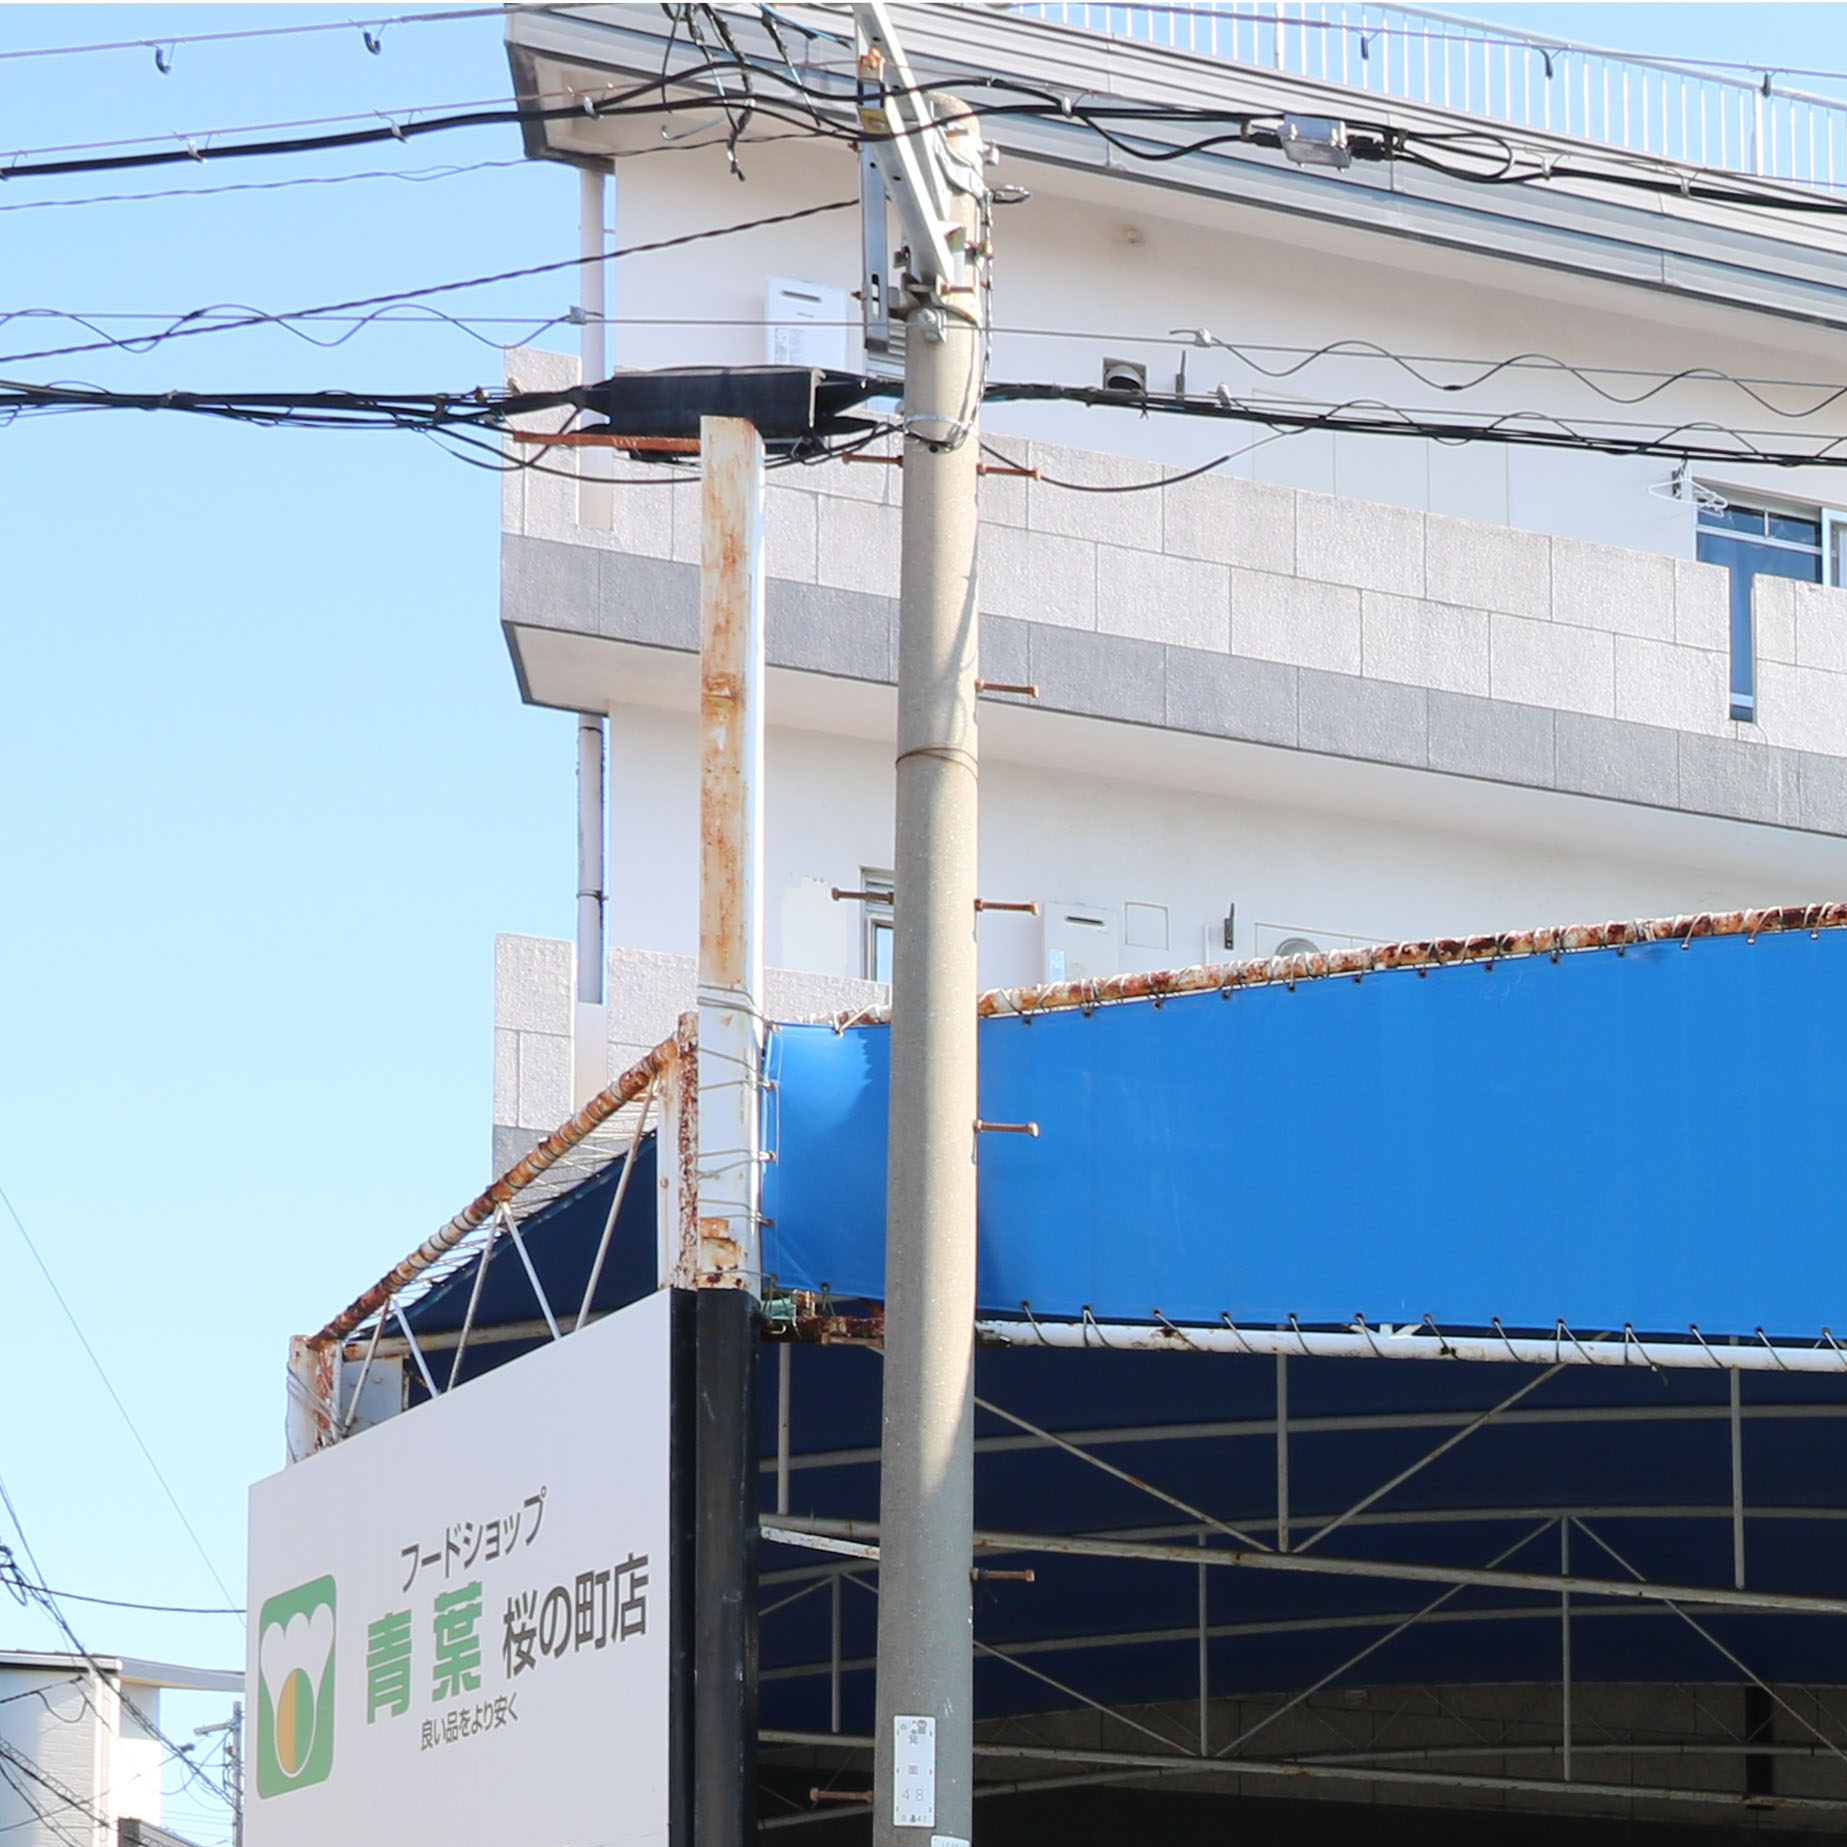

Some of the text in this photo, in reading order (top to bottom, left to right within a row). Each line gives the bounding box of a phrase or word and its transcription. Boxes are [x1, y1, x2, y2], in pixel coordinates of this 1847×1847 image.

[401, 1486, 548, 1593] フードショップ
[366, 1552, 650, 1725] 青葉 桜の町店
[420, 1692, 519, 1752] 良い品をより安く
